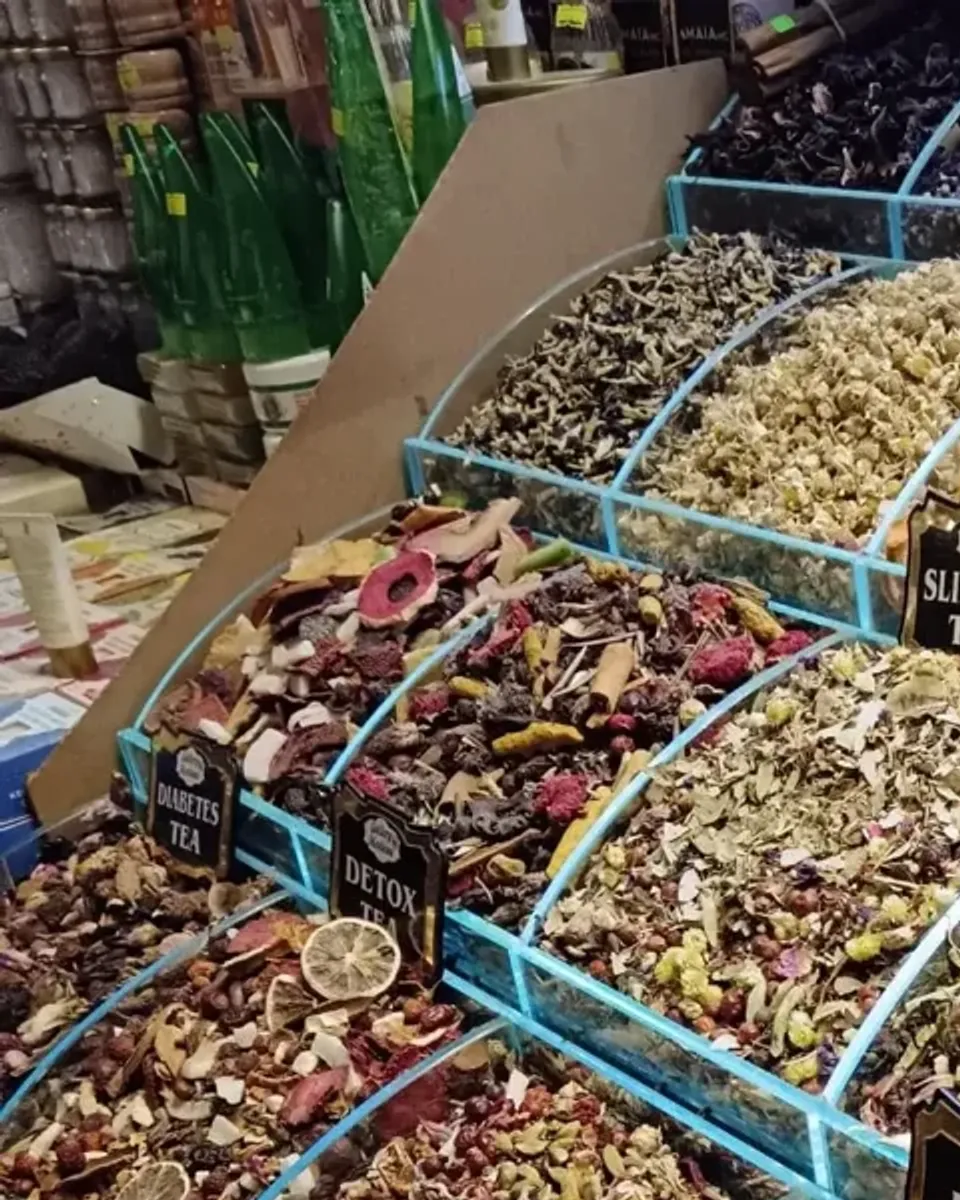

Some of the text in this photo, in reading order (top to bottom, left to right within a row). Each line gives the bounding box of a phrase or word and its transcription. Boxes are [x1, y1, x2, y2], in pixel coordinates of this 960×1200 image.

[158, 782, 219, 826] DIABETES
[170, 820, 200, 855] TEA
[344, 854, 418, 918] DETOX
